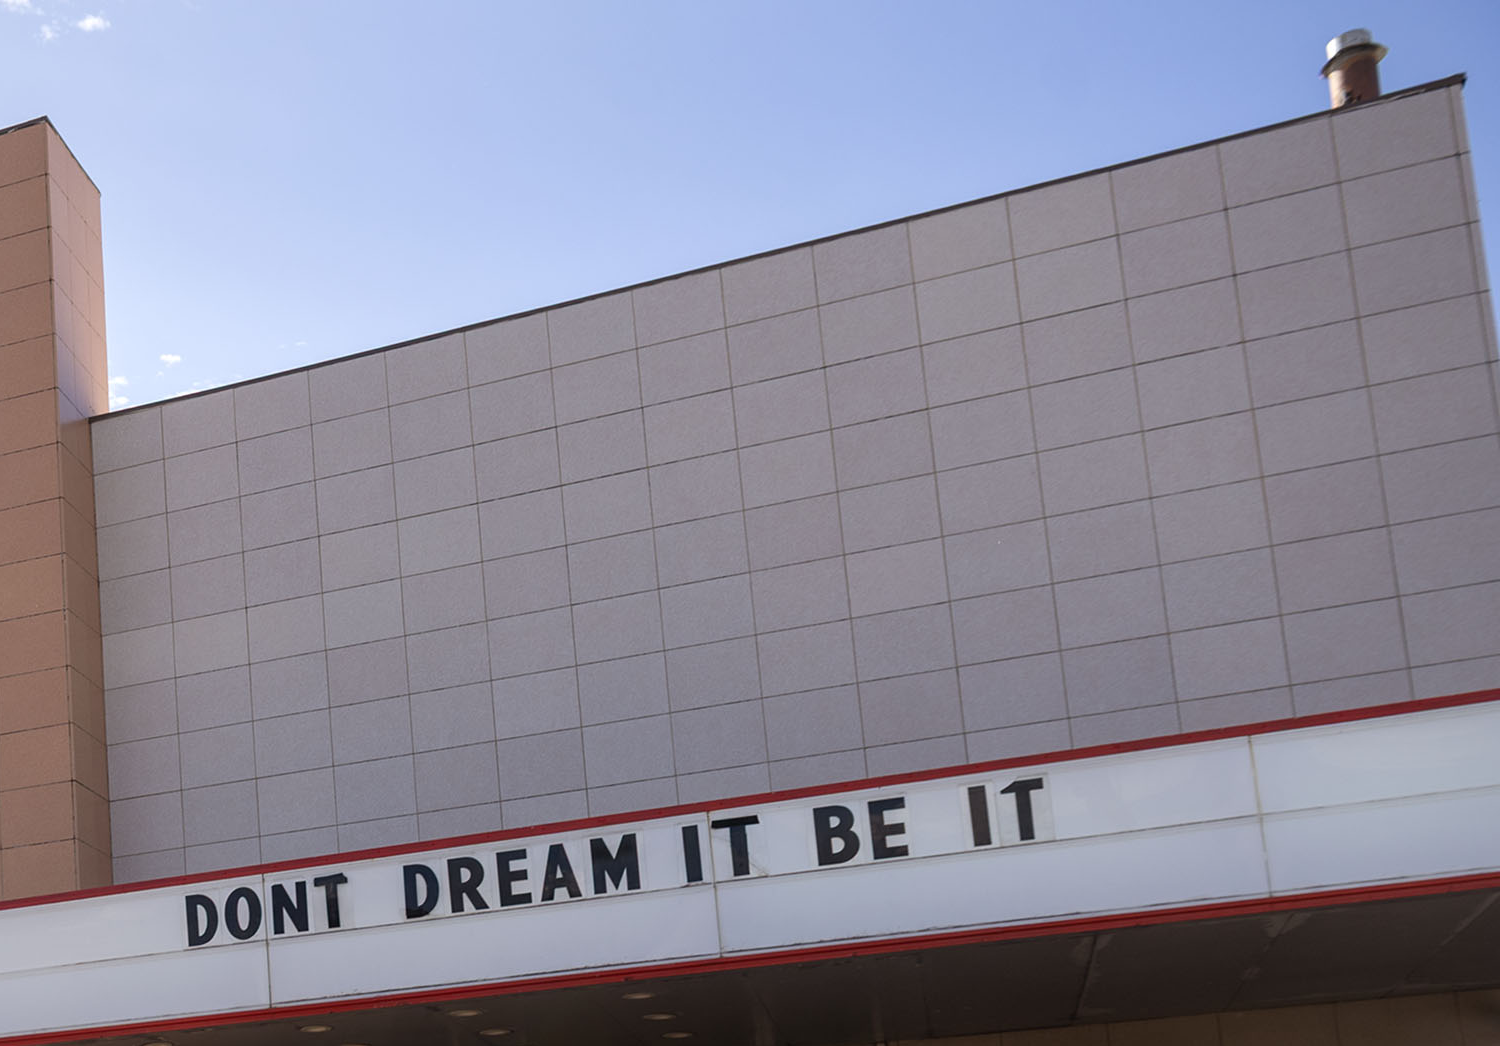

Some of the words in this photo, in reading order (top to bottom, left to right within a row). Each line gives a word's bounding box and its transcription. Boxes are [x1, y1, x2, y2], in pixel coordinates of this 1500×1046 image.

[184, 872, 349, 948] DONT
[402, 833, 642, 920] DREAM
[681, 814, 760, 883] IT
[812, 797, 910, 867] BE
[967, 777, 1045, 847] IT
